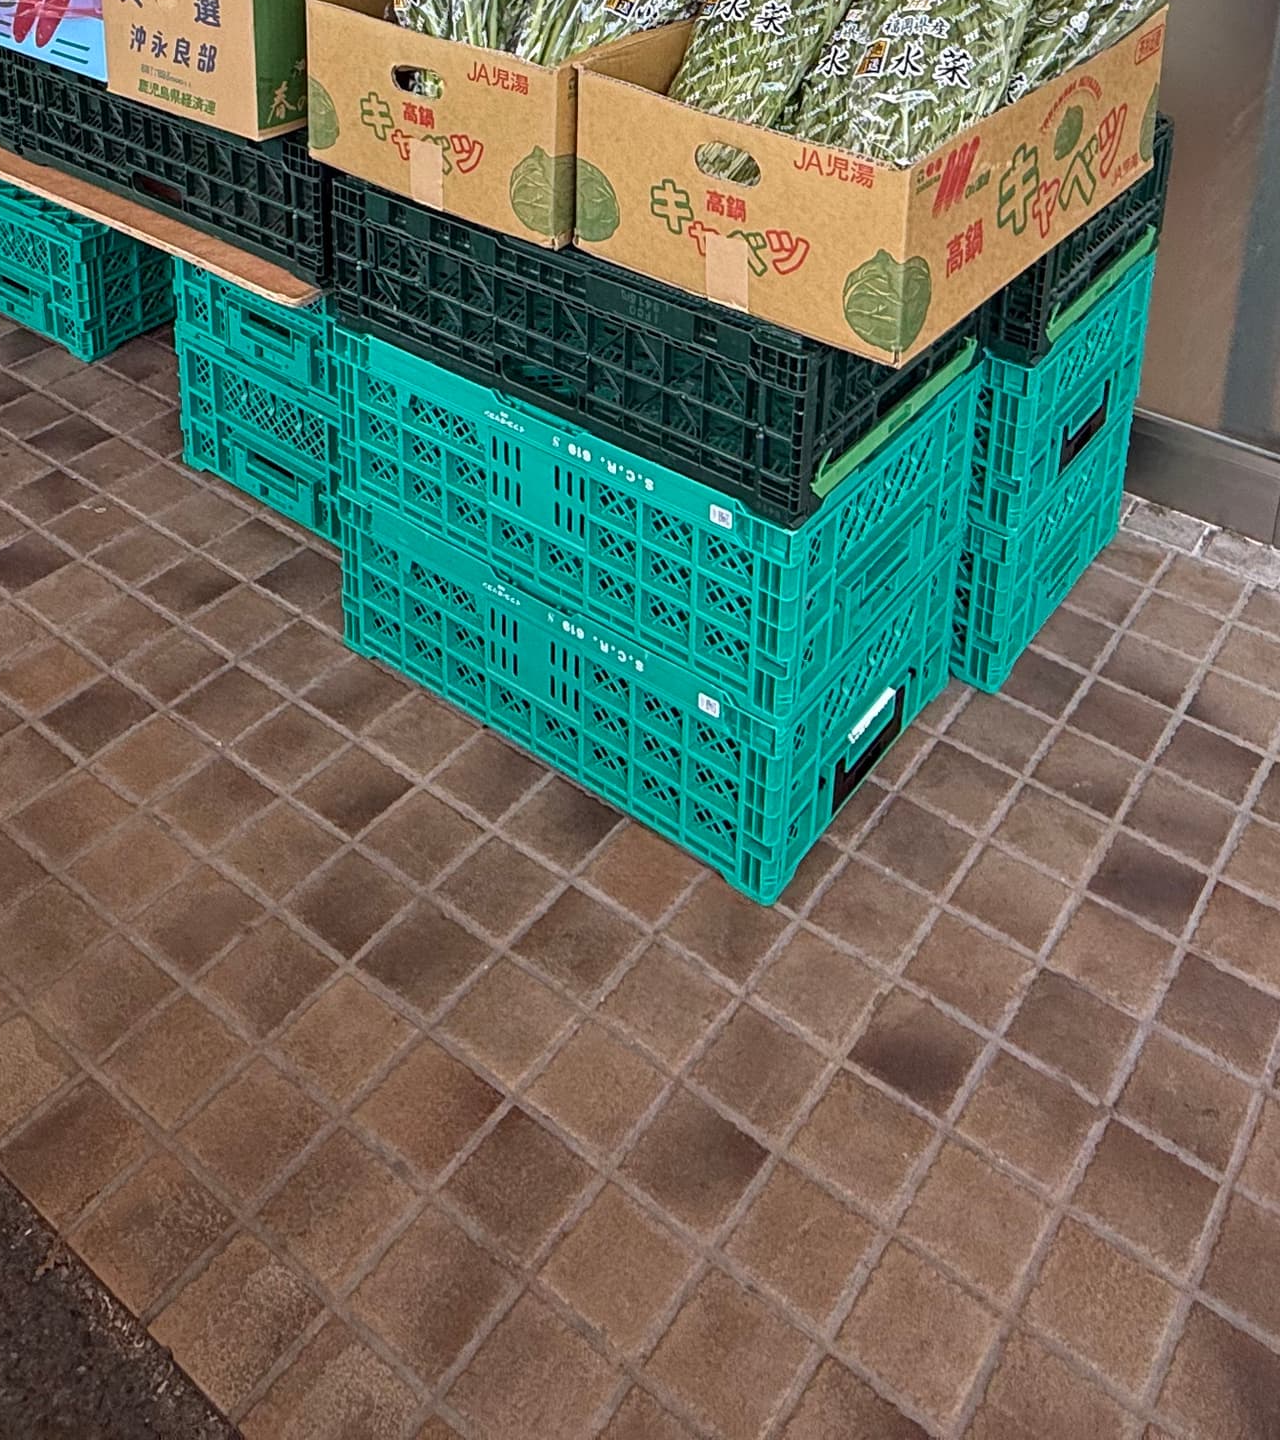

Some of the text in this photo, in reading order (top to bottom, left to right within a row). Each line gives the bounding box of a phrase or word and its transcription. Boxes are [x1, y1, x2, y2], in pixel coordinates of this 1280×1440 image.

[883, 13, 951, 40] 福岡県産
[129, 23, 218, 74] 沖永良部
[891, 42, 971, 88] 水菜
[137, 78, 217, 116] 鹿児島県経済連
[467, 61, 529, 96] JA児湯
[402, 101, 435, 129] 高鍋
[793, 147, 875, 189] JA児湯
[996, 103, 1128, 239] キャベツ
[705, 189, 747, 223] 高鍋
[945, 217, 984, 279] 高鍋
